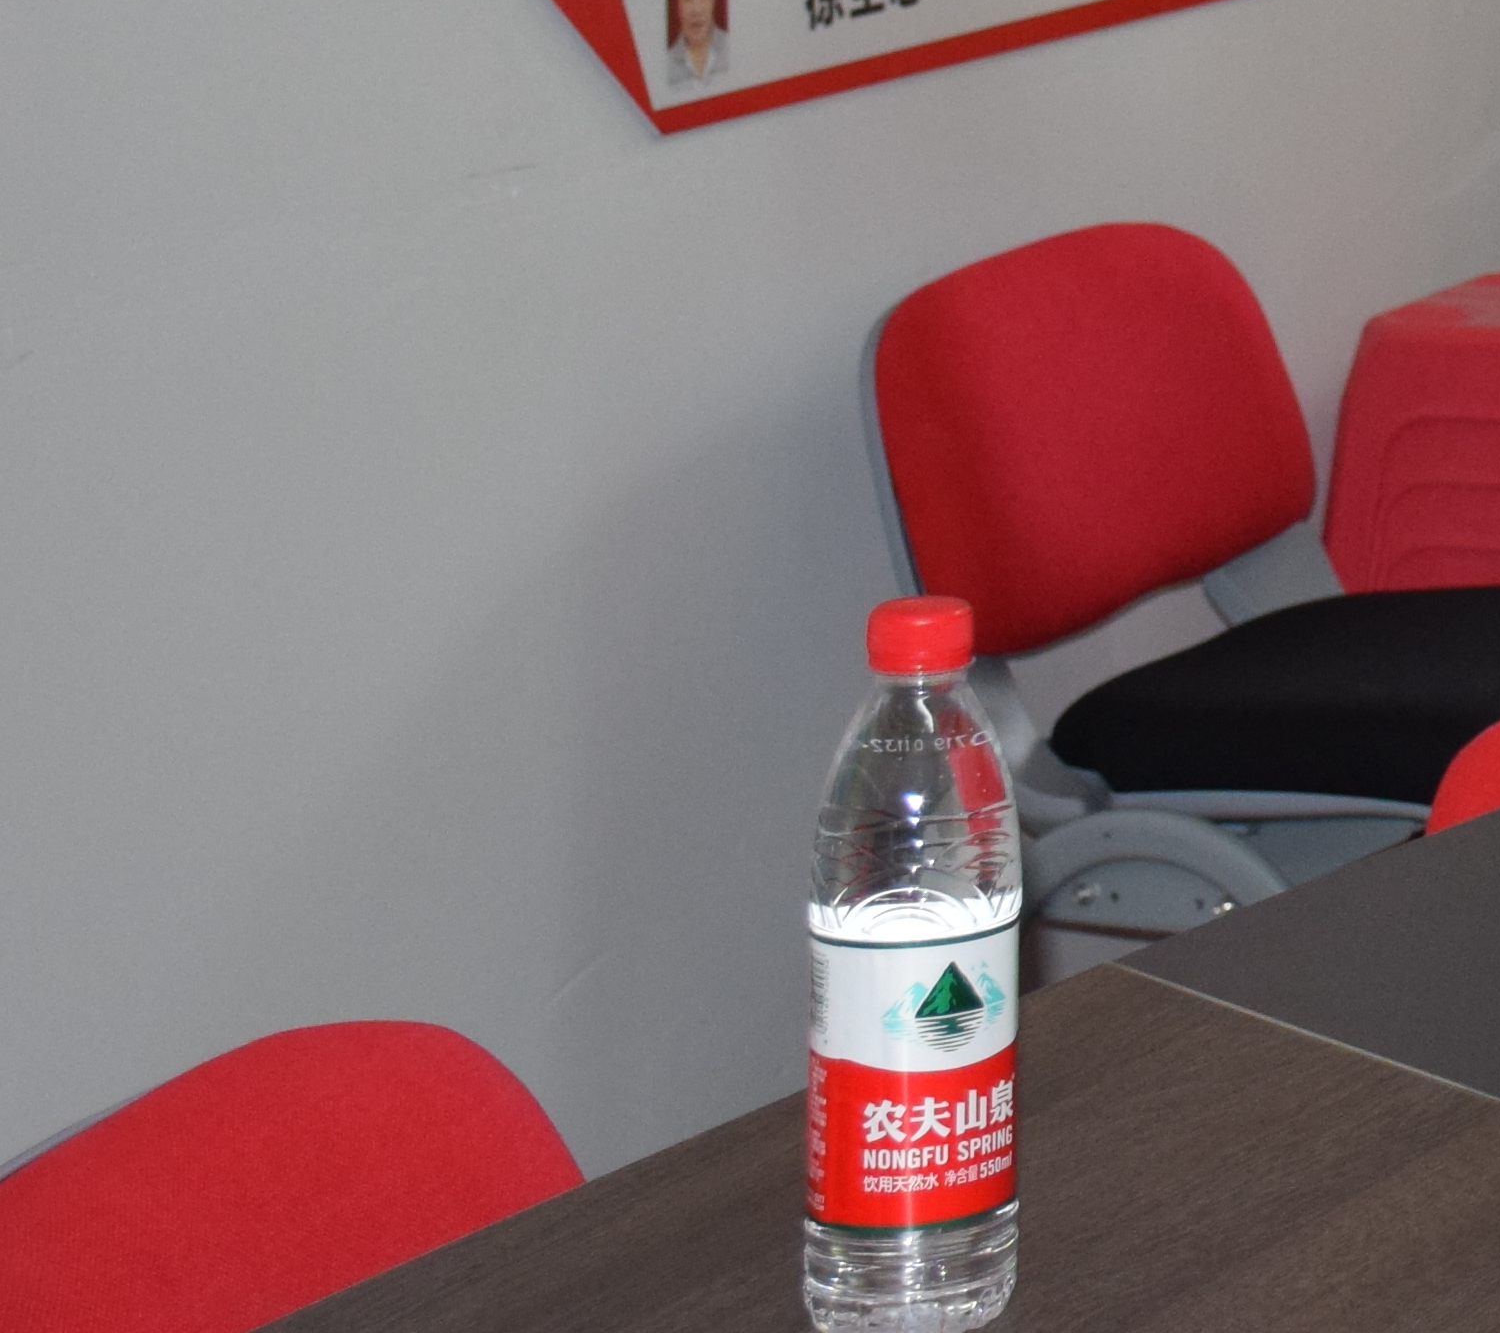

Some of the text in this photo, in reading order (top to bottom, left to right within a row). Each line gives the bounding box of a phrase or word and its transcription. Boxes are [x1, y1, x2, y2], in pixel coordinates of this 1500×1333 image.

[862, 1079, 1014, 1143] 农夫山泉
[863, 1125, 1013, 1170] NONGFU SPRING
[863, 1172, 939, 1194] 饮用天然水
